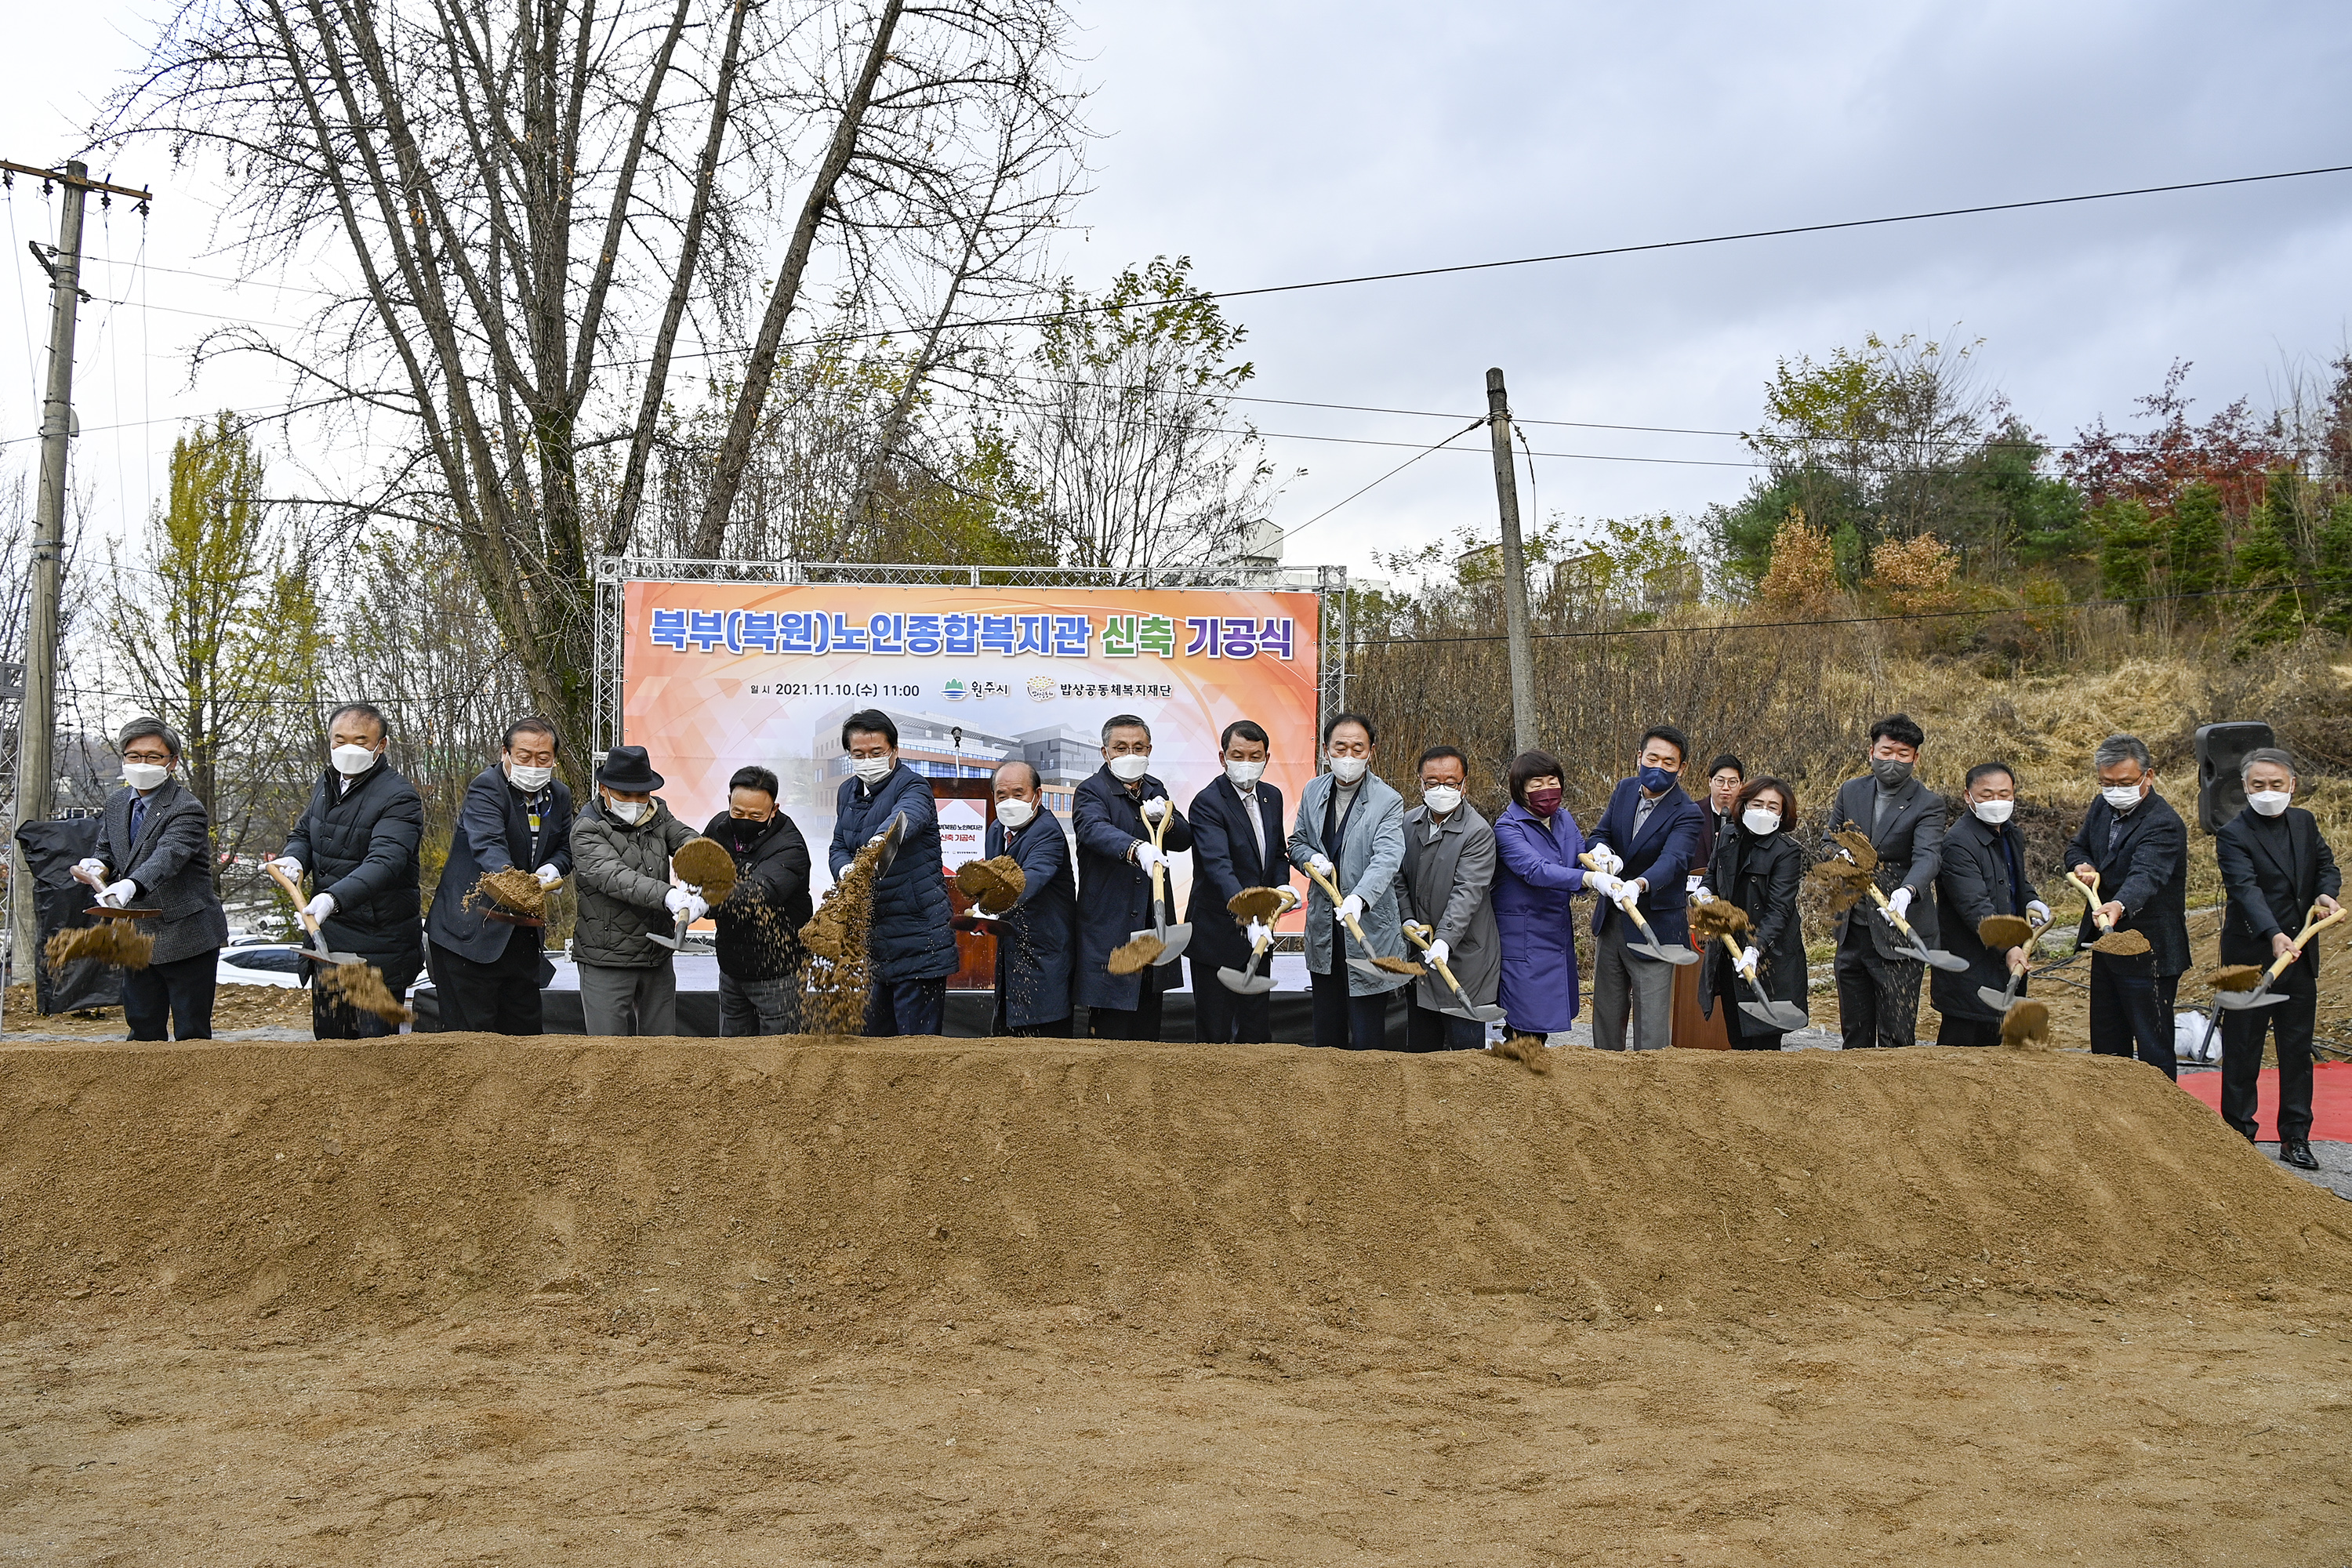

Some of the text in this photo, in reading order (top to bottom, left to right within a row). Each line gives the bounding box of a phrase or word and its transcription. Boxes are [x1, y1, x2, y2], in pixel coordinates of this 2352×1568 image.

[650, 608, 1294, 659] 북부(북원)노인종합복지관 신축 기공식
[775, 683, 877, 697] 2021.11.10.(수)
[884, 684, 920, 696] 11:00
[971, 681, 1008, 697] 원주시
[1060, 684, 1172, 696] 밥상공동체복지재단
